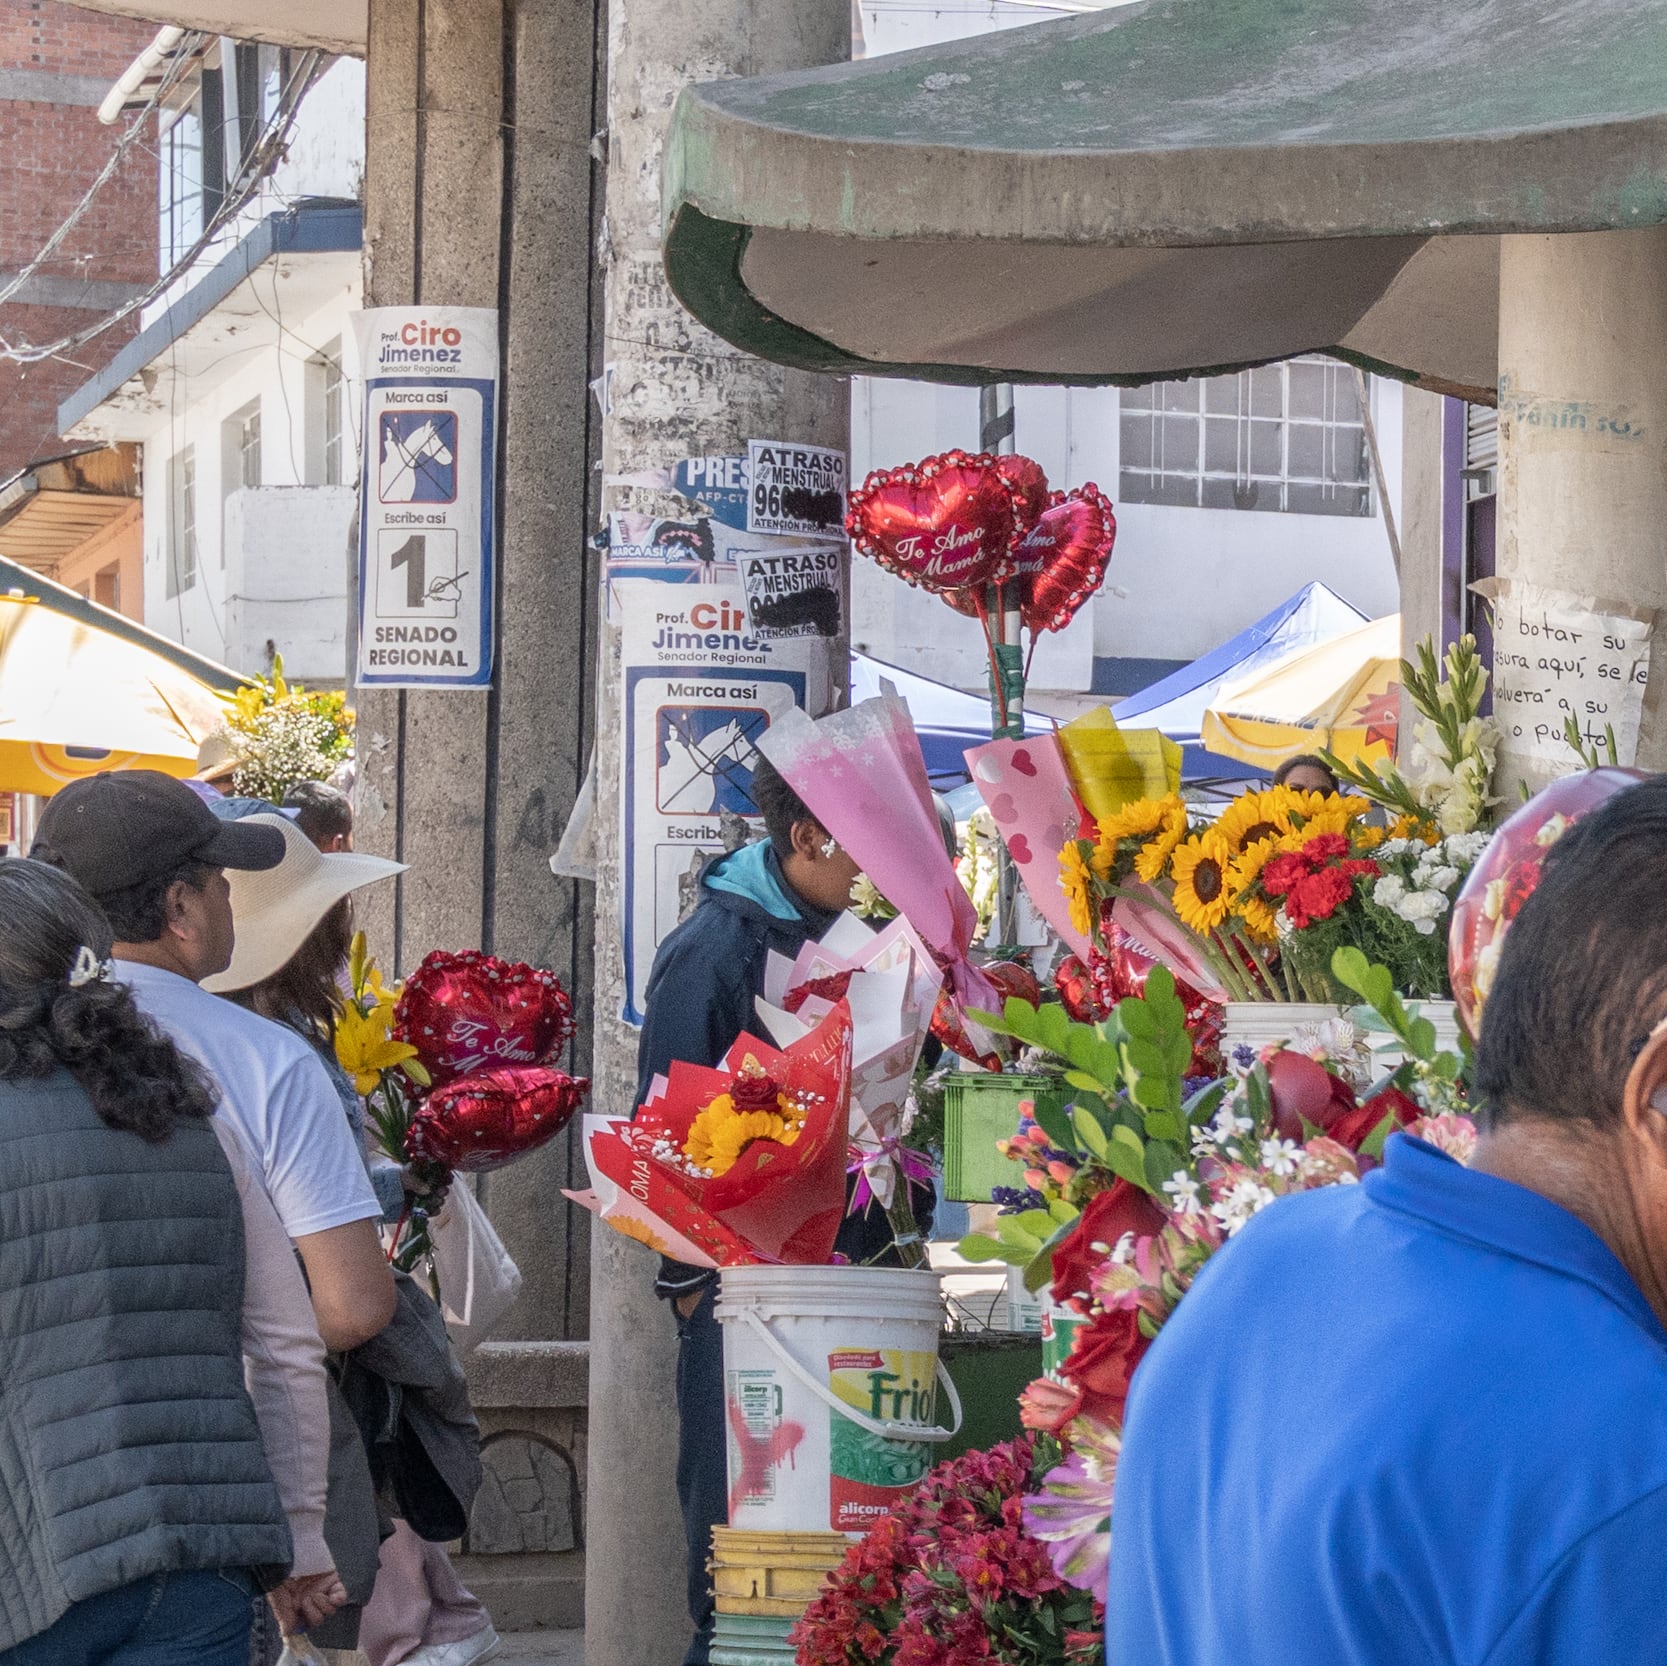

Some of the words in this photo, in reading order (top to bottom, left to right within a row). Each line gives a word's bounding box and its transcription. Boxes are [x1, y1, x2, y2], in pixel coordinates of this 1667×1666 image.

[381, 332, 400, 342] Prof.
[401, 320, 461, 346] Ciro
[379, 344, 461, 363] Jimenez
[381, 365, 411, 373] Senador
[414, 364, 456, 374] Regional
[385, 392, 423, 403] Marca
[426, 391, 448, 403] así
[758, 448, 842, 474] ATRASO
[772, 467, 835, 490] MENSTRUAL
[696, 491, 745, 504] AFP-CT
[385, 512, 424, 524] Escribe
[426, 512, 446, 524] así
[754, 518, 800, 530] ATENCIÓN
[612, 546, 641, 557] MARCA
[896, 536, 925, 561] Te
[931, 524, 985, 555] Amo
[391, 535, 426, 607] 1
[748, 554, 837, 577] ATRASO
[920, 547, 985, 577] Mamá
[764, 571, 830, 593] MENSTRUAL
[656, 612, 688, 624] Prof.
[690, 600, 745, 631] Cir
[375, 627, 458, 643] SENADO
[1520, 605, 1583, 643] botar
[1603, 635, 1625, 650] su
[369, 649, 468, 667] REGIONAL
[658, 651, 708, 662] Senador
[711, 652, 766, 665] Regional
[1598, 664, 1621, 680] se
[666, 683, 727, 698] Marca
[729, 684, 758, 700] así
[1558, 698, 1570, 711] a
[1586, 700, 1608, 714] su
[446, 1020, 489, 1048] Te
[483, 1035, 536, 1060] Amo
[631, 1160, 651, 1206] OMA
[839, 1502, 889, 1516] alicorp
